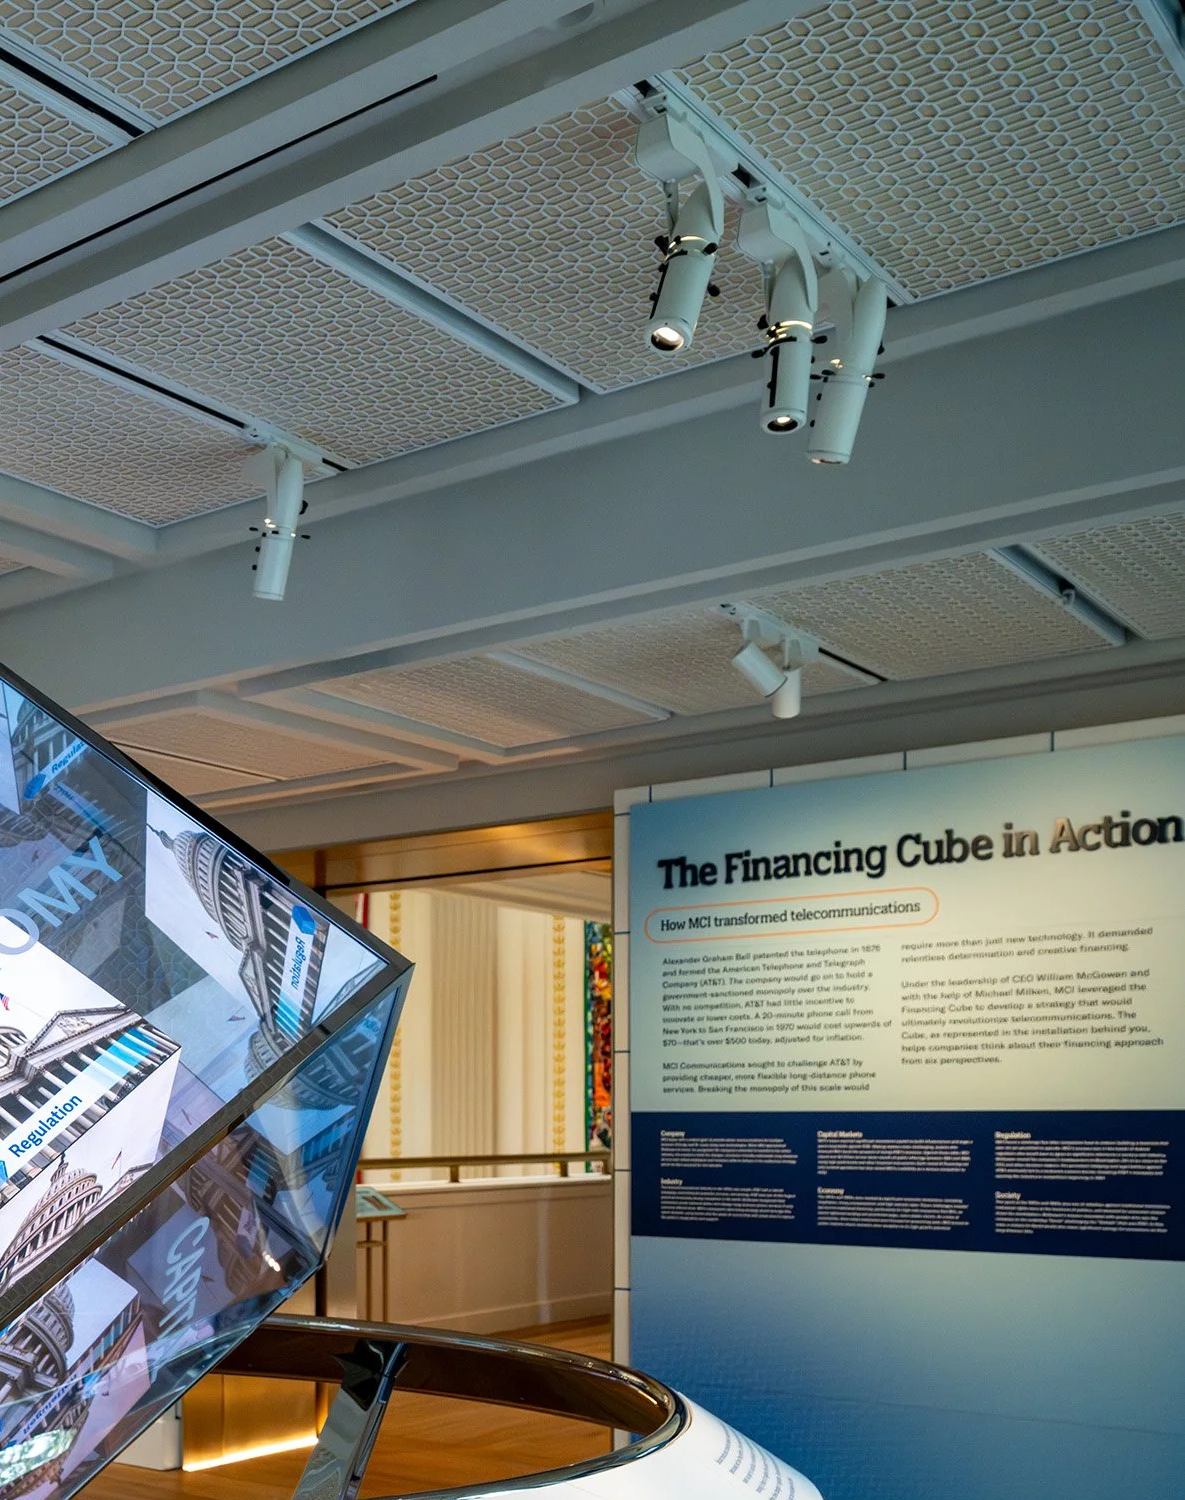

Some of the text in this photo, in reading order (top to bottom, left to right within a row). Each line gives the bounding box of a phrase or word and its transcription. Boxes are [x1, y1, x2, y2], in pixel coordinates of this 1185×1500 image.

[657, 810, 1184, 890] The Financing Cube in Action
[661, 901, 921, 932] How MCI transformed telecommunications
[8, 1095, 83, 1158] Regulation
[995, 1191, 1021, 1200] Society
